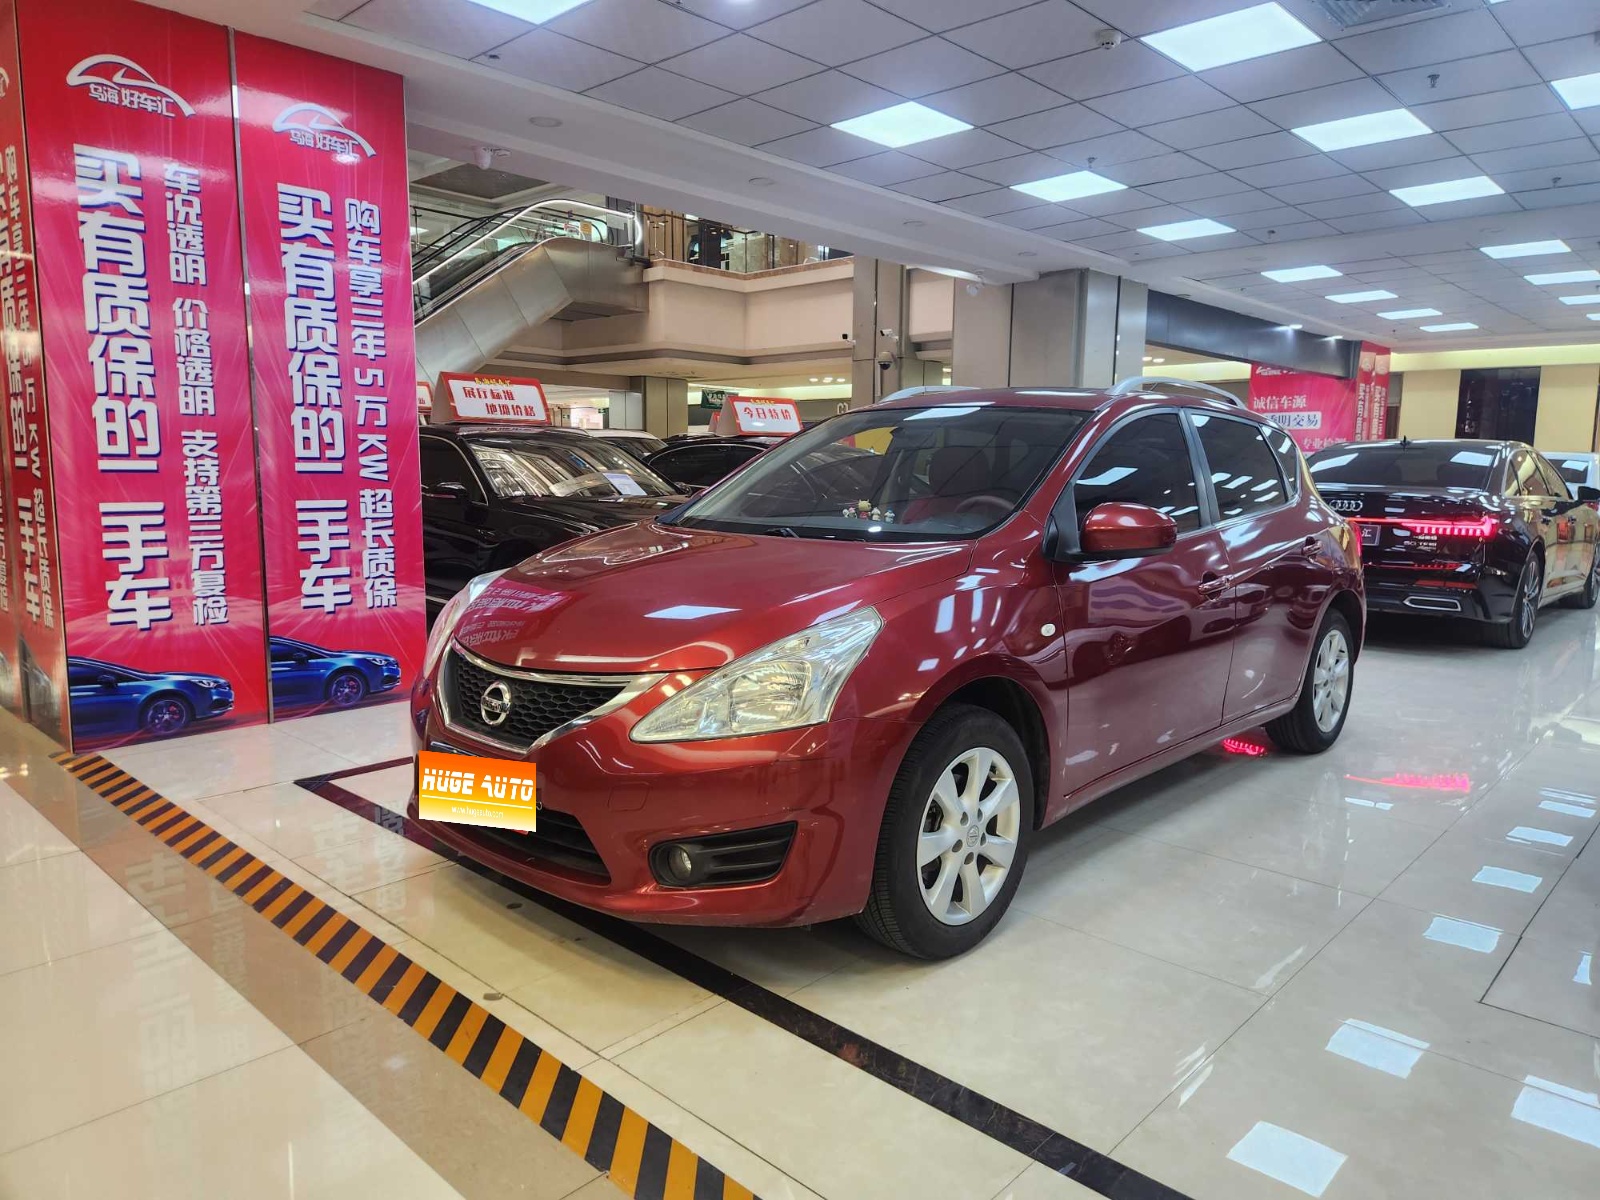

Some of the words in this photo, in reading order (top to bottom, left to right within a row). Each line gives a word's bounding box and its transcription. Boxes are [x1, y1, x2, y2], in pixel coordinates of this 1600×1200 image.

[163, 162, 207, 286] 车况透明
[73, 143, 173, 630] 买有质保的二手车
[172, 297, 216, 416] 价格透明
[277, 182, 353, 614] 买有质保的二手车
[181, 430, 229, 626] 支持第三方复检
